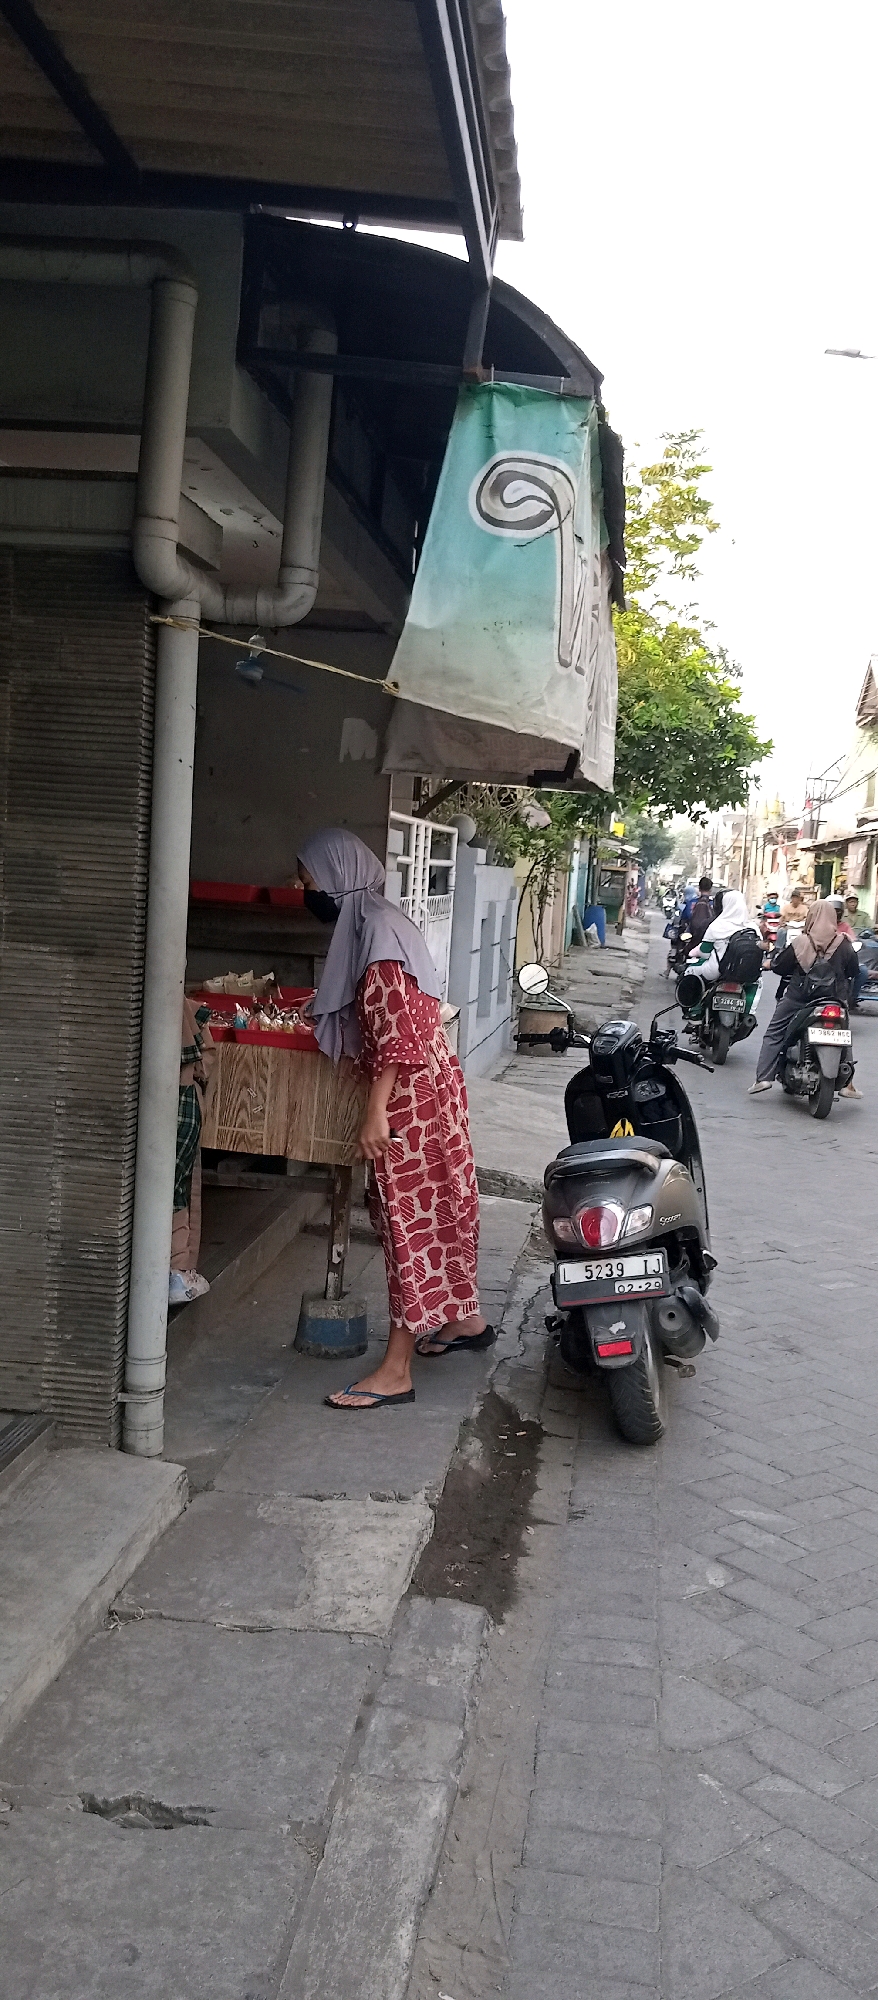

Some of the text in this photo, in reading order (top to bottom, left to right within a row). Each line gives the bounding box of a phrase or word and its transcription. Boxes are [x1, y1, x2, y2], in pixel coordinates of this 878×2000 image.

[563, 1258, 662, 1283] L 5239 IJ
